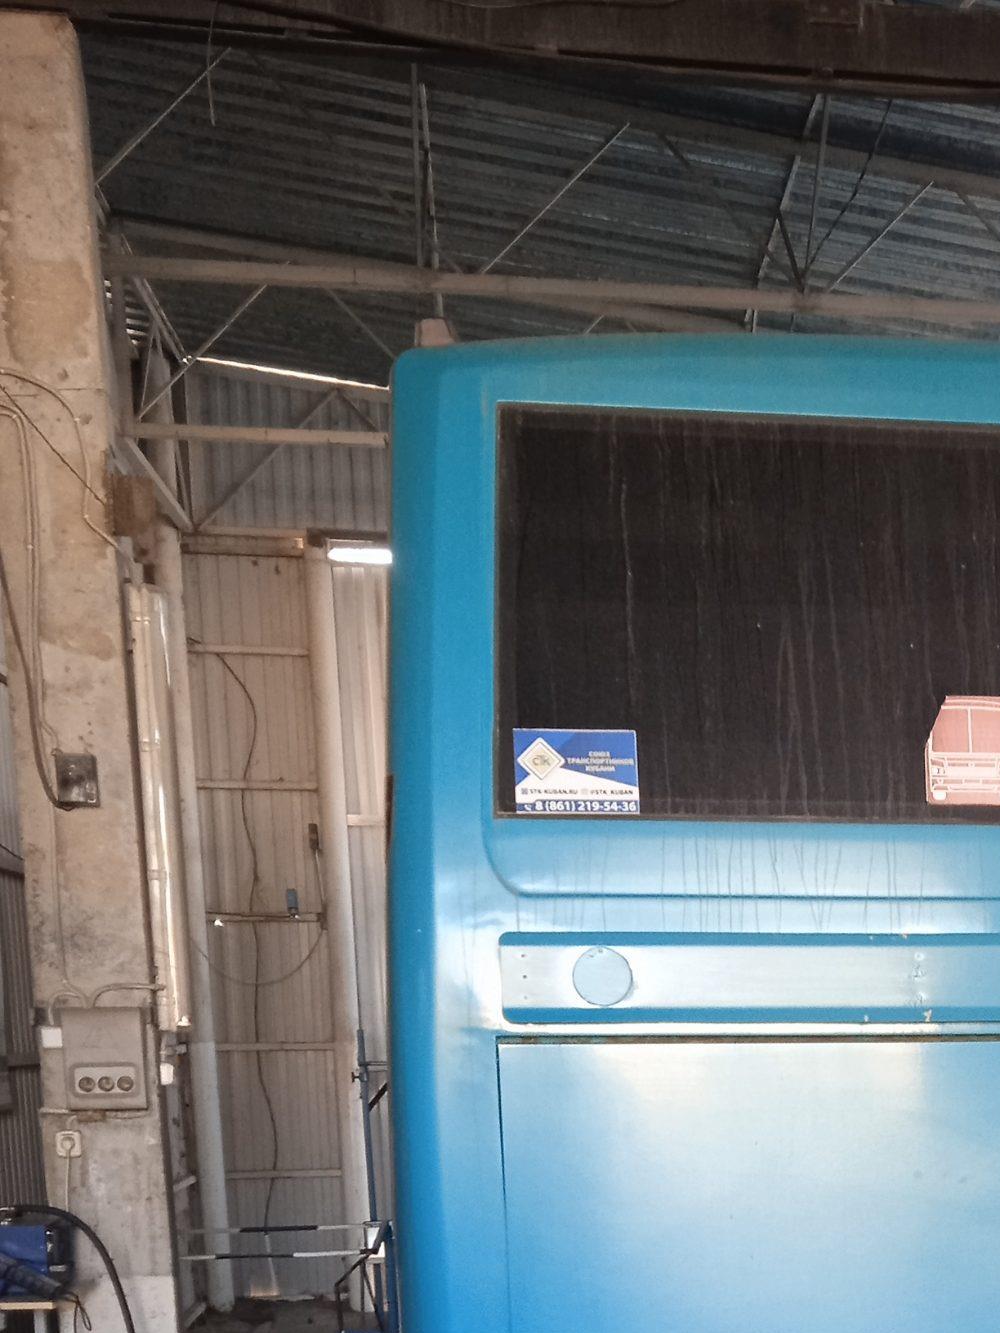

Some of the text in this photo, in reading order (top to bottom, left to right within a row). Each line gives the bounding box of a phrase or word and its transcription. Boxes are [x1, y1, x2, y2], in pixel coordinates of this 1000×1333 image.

[535, 801, 637, 813] 8 (861) 219-54-36
